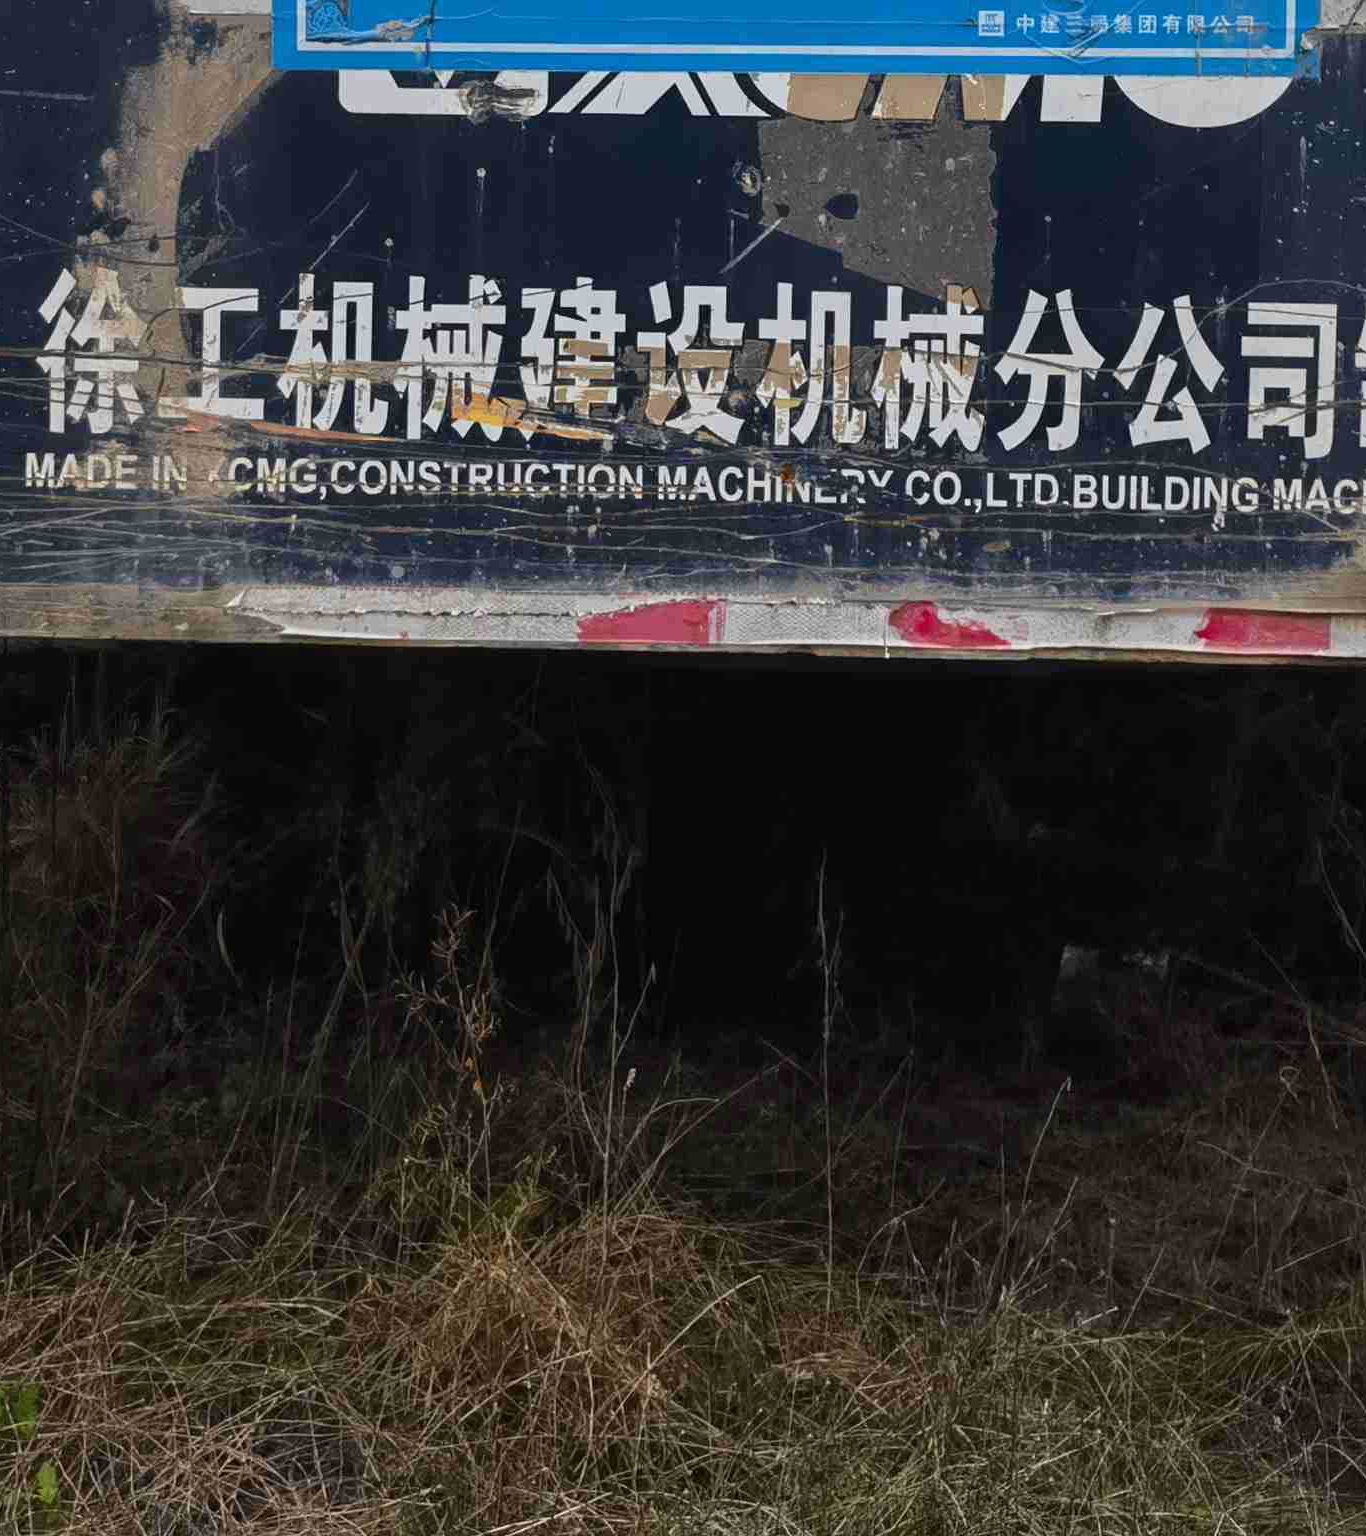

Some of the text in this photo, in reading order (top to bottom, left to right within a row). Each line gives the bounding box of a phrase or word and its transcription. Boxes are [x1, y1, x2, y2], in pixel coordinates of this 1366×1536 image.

[25, 451, 138, 490] MADE
[152, 454, 189, 491] IN
[203, 456, 644, 500] CMG,CONSTRUCTION
